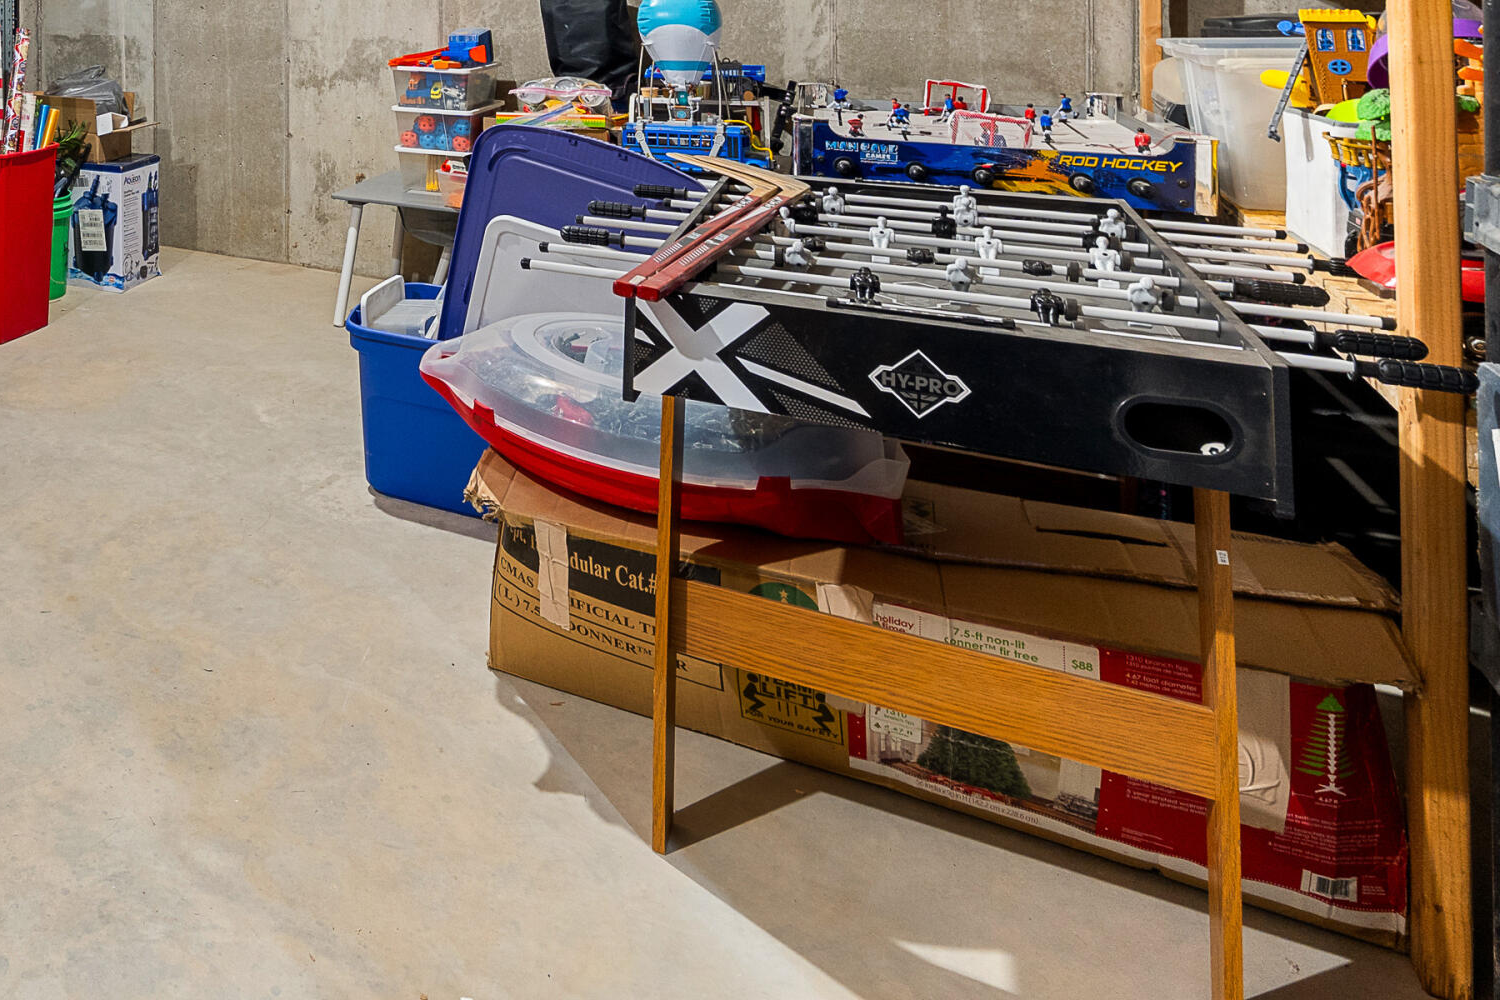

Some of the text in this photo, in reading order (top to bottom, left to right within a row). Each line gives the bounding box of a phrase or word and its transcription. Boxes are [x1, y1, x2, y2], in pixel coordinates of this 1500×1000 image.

[865, 152, 891, 160] GAMES
[1059, 154, 1184, 173] ROD HOCKEY
[881, 370, 961, 396] HY-PRO
[570, 552, 611, 581] dular
[500, 556, 535, 588] CMAS
[570, 597, 635, 629] IFICIAL
[875, 612, 915, 630] holiday
[953, 627, 1026, 650] 7.5-ft non-lit
[1013, 648, 1039, 664] tree
[1071, 658, 1094, 673] $88
[761, 682, 813, 706] LIFT
[768, 714, 795, 727] YOUR
[796, 723, 839, 739] SAFETY
